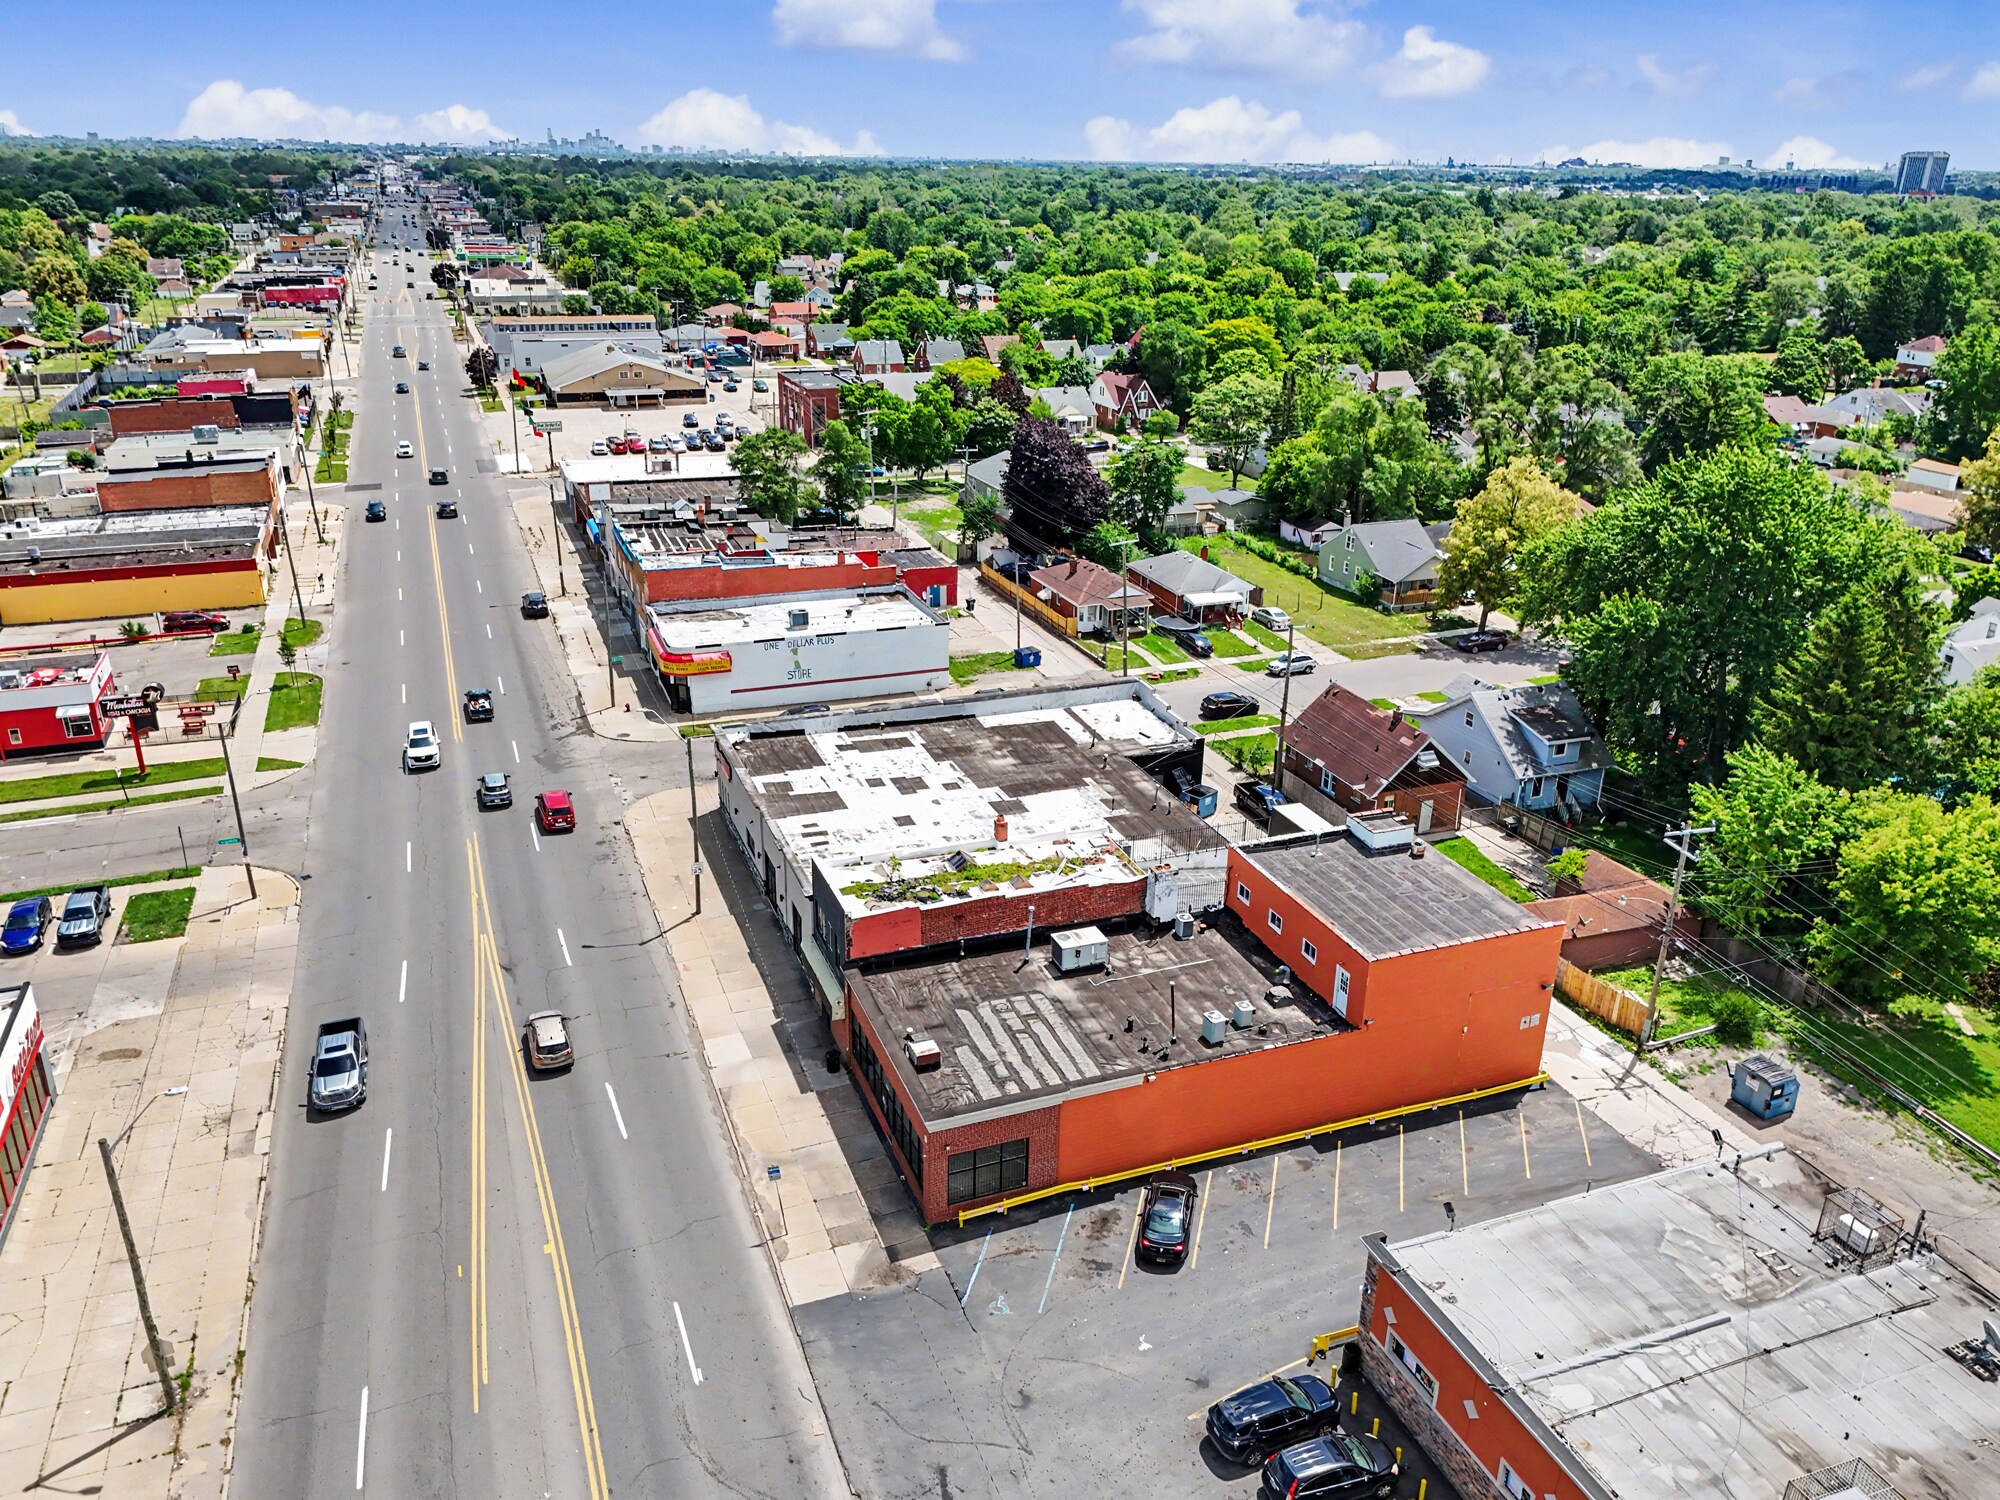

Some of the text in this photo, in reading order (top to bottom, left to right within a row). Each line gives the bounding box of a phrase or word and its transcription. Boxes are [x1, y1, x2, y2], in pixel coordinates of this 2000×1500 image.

[764, 642, 780, 651] ONE
[817, 636, 835, 645] PLUS
[787, 668, 812, 680] STORE
